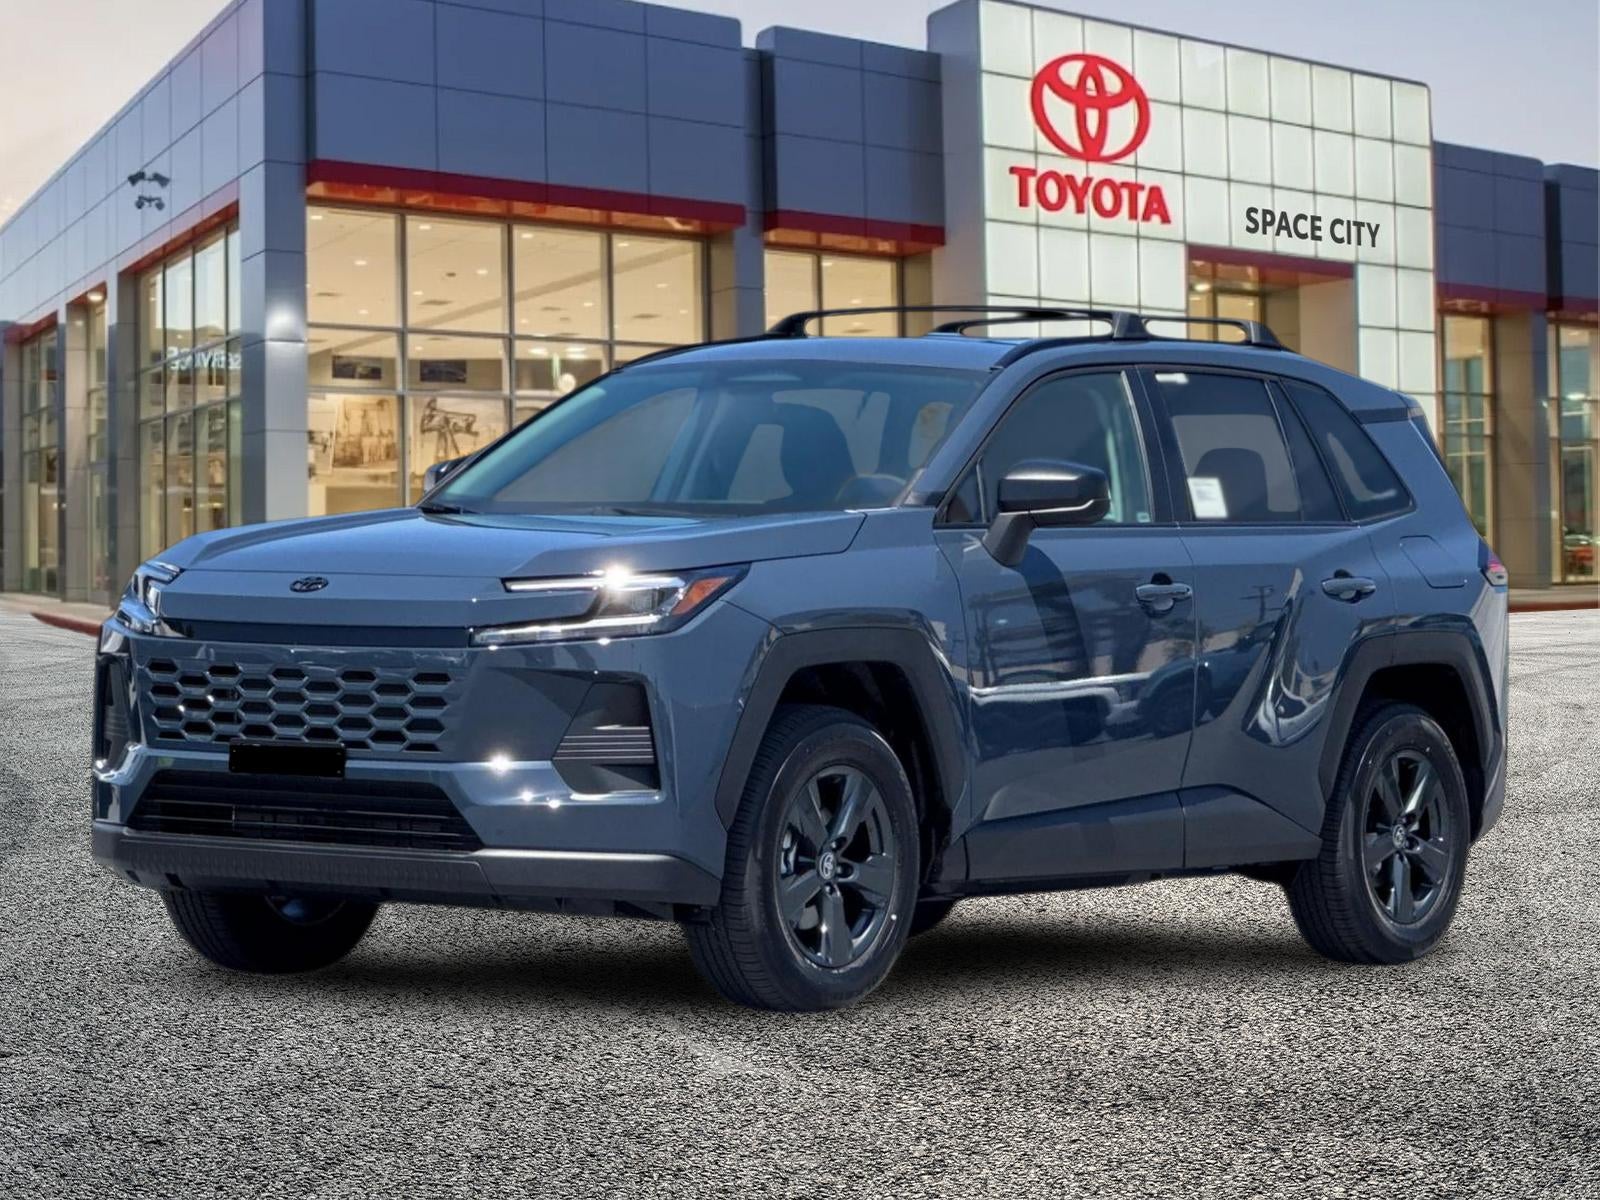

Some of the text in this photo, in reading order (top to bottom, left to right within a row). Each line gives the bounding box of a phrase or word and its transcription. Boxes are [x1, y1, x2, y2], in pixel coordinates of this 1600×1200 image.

[1009, 166, 1171, 224] TOYOTA
[1245, 206, 1381, 248] SPACE CITY
